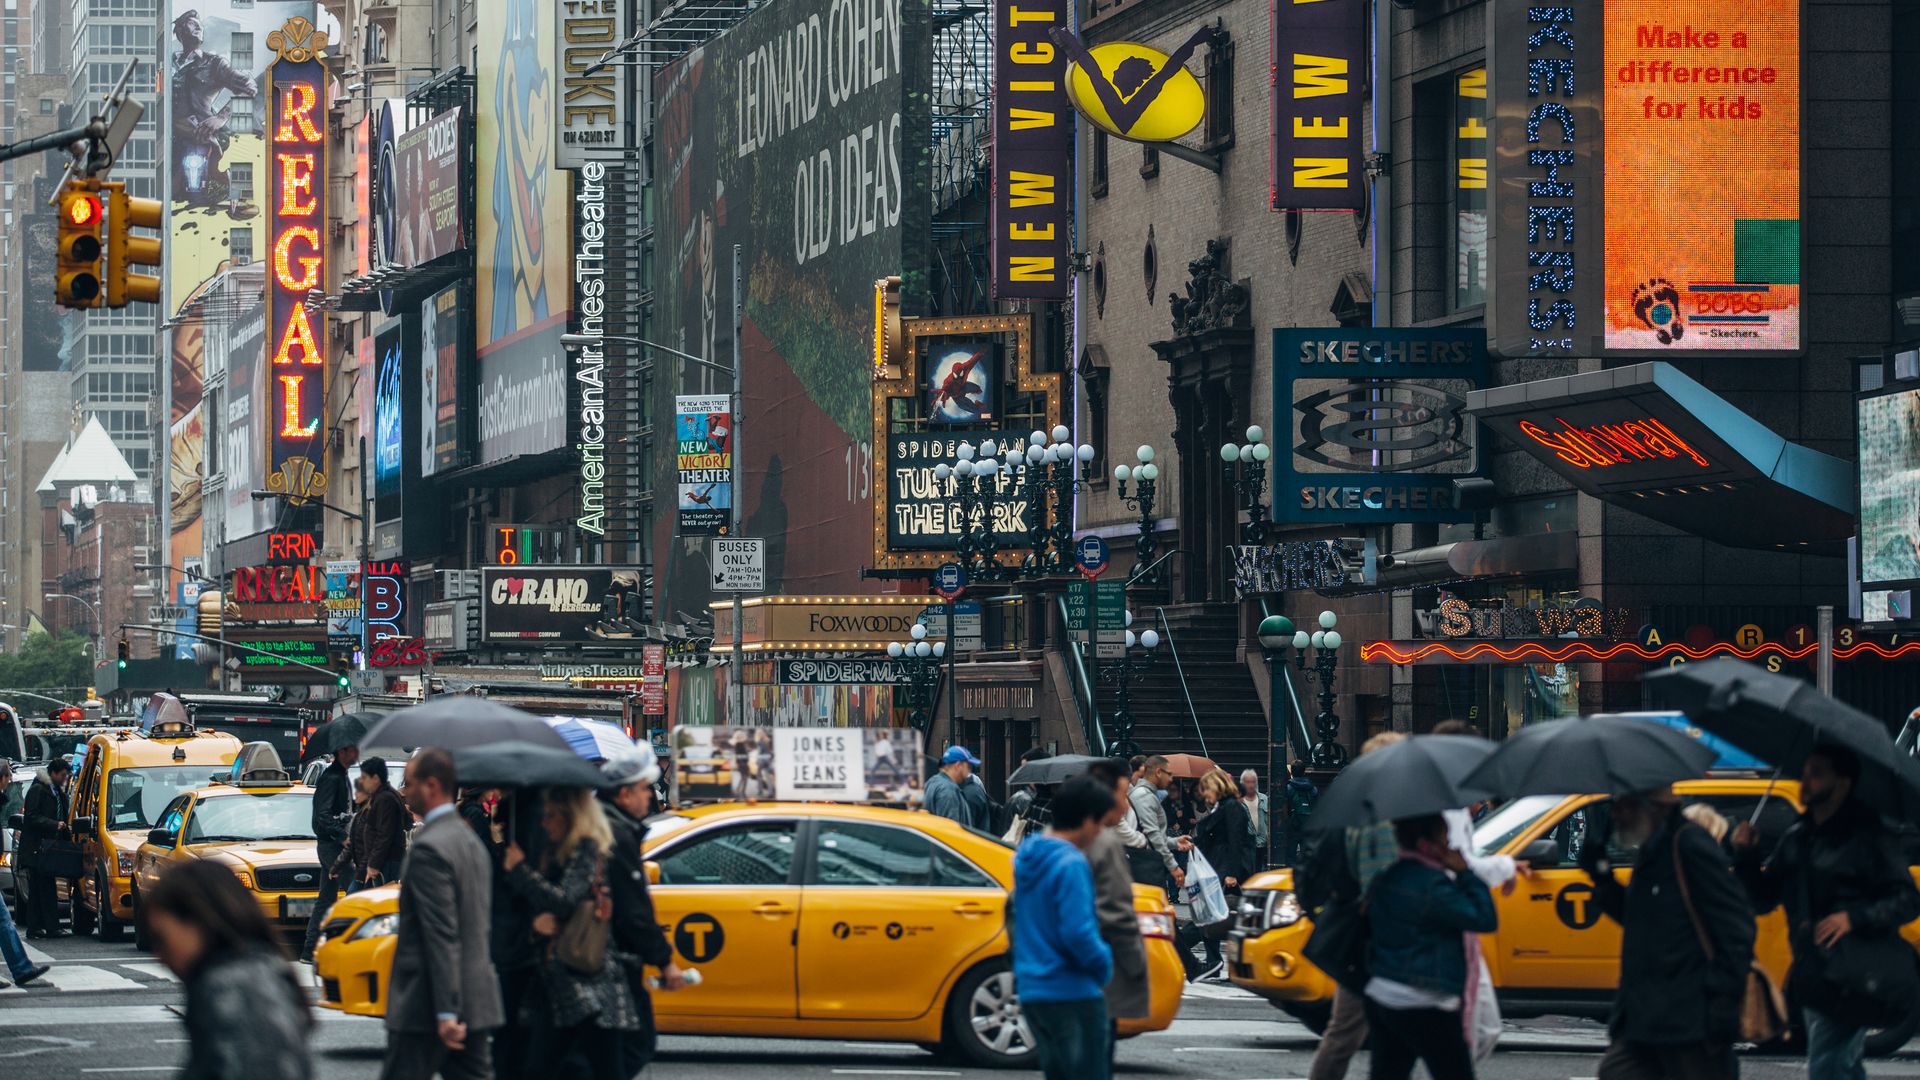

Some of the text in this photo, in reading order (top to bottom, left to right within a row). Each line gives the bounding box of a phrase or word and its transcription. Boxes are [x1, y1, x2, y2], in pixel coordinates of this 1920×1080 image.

[563, 0, 616, 14] THE
[1636, 24, 1747, 50] Make a
[564, 17, 616, 126] DUKE
[739, 0, 901, 158] LEONARD COHEN
[1617, 61, 1776, 85] difference
[1642, 95, 1762, 120] for kids
[1293, 53, 1348, 188] NEW
[428, 113, 456, 161] BODIES
[604, 130, 616, 142] ST
[794, 112, 902, 265] OLD IDEAS
[1010, 170, 1054, 281] NEW
[273, 80, 323, 437] REGAL
[1695, 293, 1763, 314] BOBS
[576, 161, 604, 535] AmericanAirnesTheatre
[1300, 340, 1466, 363] SKECHERS
[680, 441, 708, 454] NEW
[1519, 417, 1710, 468] Subway
[680, 454, 729, 469] VICTORY
[679, 469, 730, 483] THEATER
[1300, 487, 1450, 510] SKECHER
[896, 501, 1028, 535] THE DARK
[718, 542, 757, 552] BUSES
[722, 555, 753, 565] ONLY
[235, 565, 325, 603] REGAL
[328, 590, 346, 599] NEW
[328, 609, 360, 618] THEATER
[561, 603, 601, 612] BERGERAC
[809, 613, 912, 633] FOXWOODS
[1439, 599, 1631, 642] Subway
[1646, 629, 1662, 645] A
[1744, 629, 1758, 645] R
[1795, 628, 1804, 645] 1
[1840, 628, 1853, 645] 3
[1767, 655, 1782, 672] S
[356, 671, 378, 679] NYPD
[793, 736, 846, 752] JONES
[793, 754, 815, 763] NEW
[793, 765, 847, 781] JEANS
[1564, 891, 1593, 924] T
[684, 922, 714, 958] T
